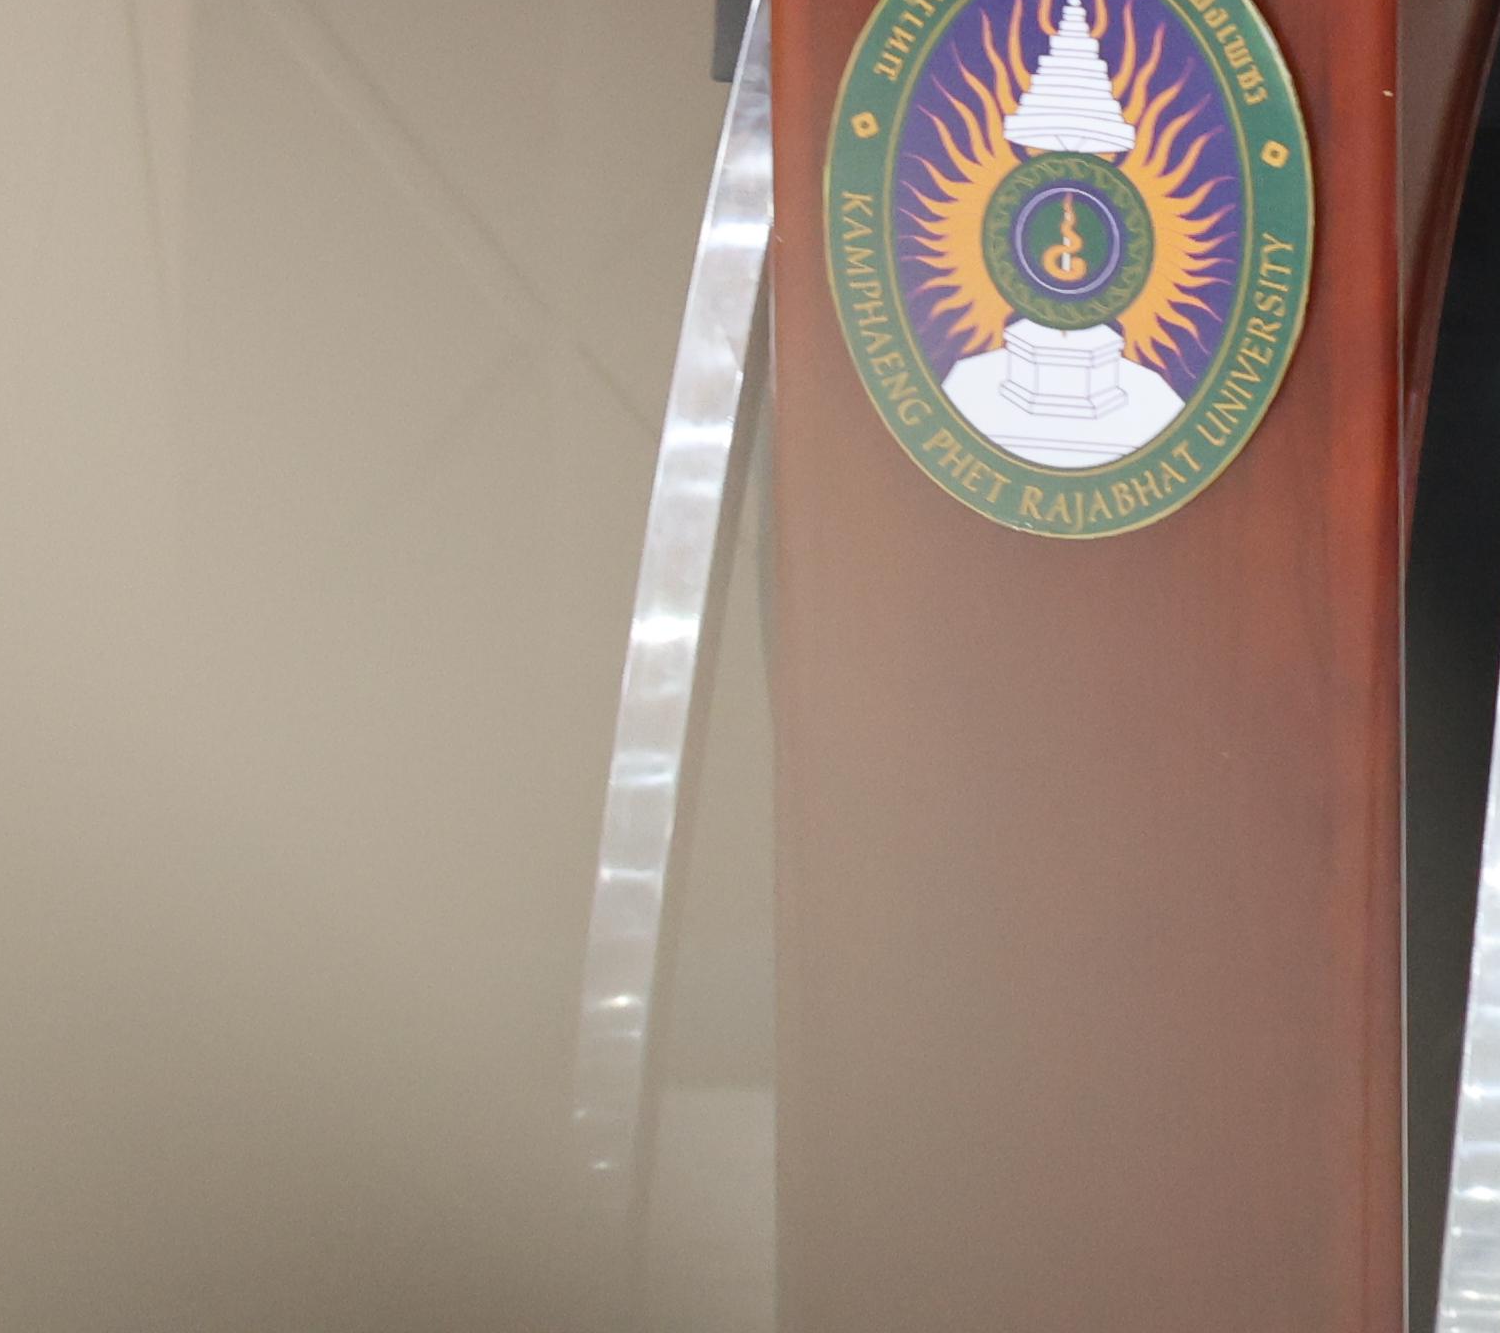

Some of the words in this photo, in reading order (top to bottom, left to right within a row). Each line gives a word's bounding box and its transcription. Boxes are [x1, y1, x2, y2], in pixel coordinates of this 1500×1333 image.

[841, 191, 933, 427] KAMPHAENG
[921, 427, 1011, 504] PHET
[1020, 441, 1202, 530] RAJABHAT
[1197, 232, 1294, 447] UNIVERSITY
